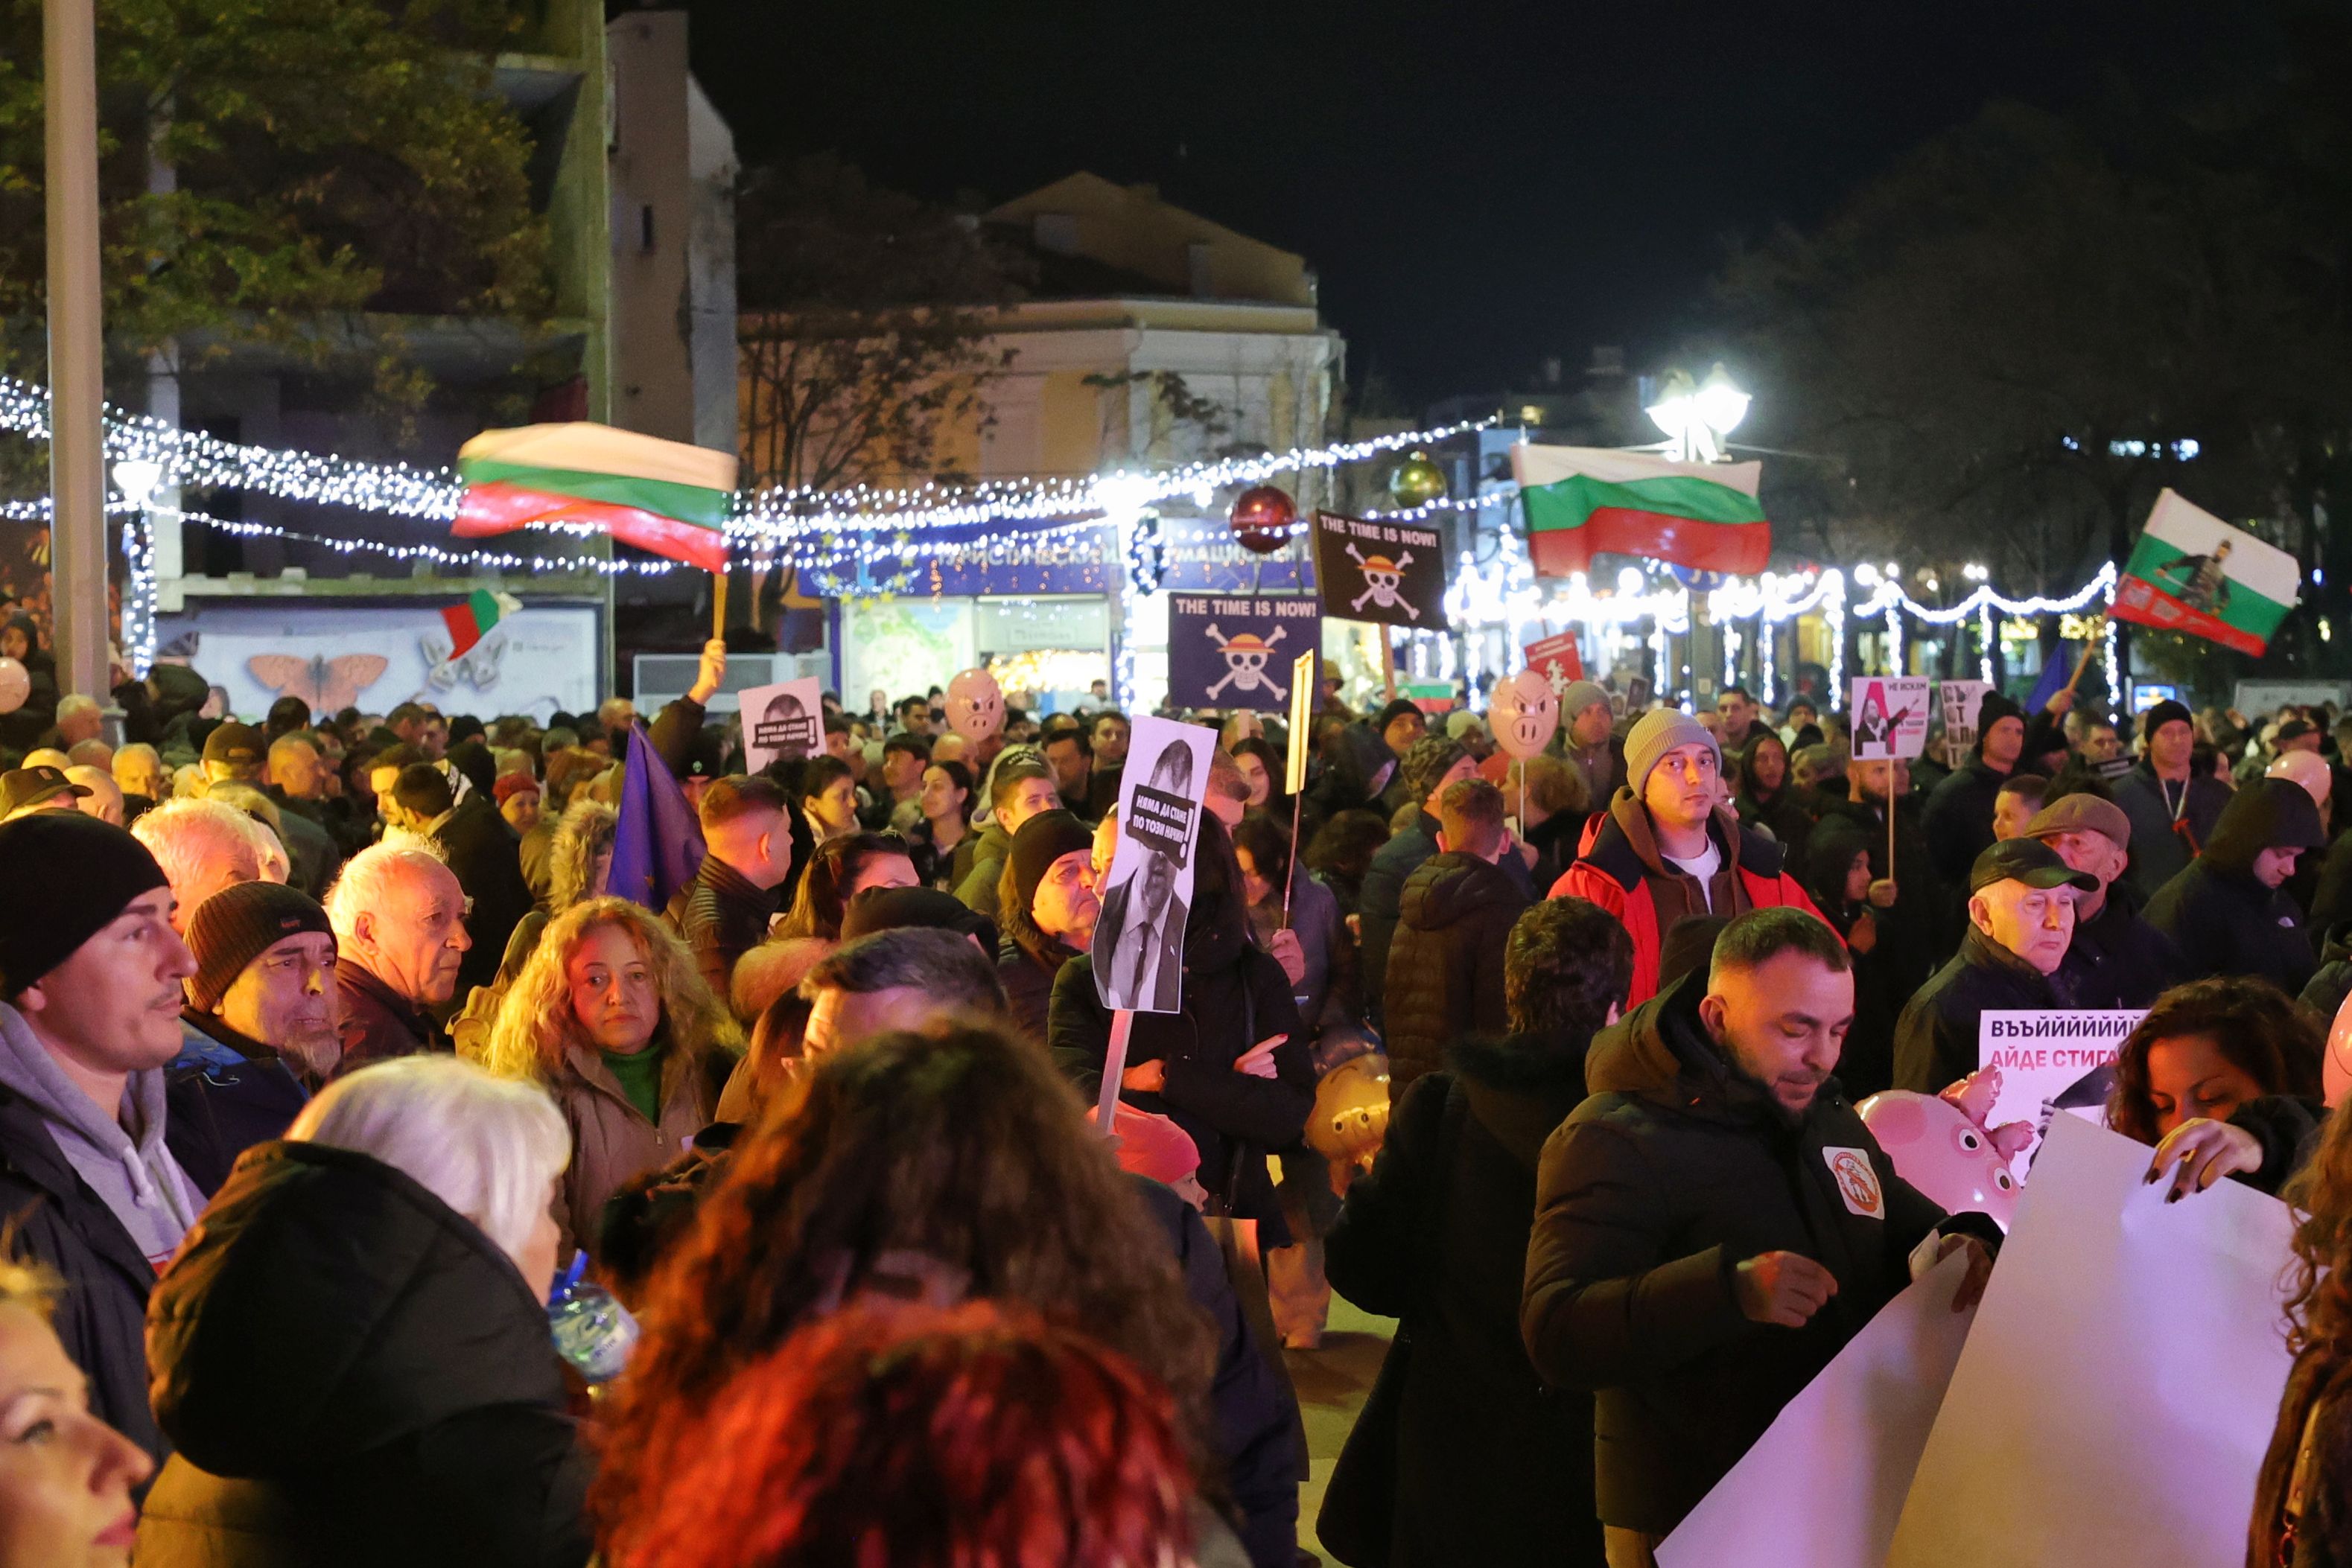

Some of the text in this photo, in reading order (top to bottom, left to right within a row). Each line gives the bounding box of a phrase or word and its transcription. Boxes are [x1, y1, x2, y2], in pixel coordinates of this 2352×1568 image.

[1320, 514, 1437, 547] THE TIME IS NOW!
[1175, 599, 1317, 617] THE TIME IS NOW!
[1136, 794, 1187, 823] НЯМА ДА СТАНЕ
[1133, 815, 1144, 829] ПО
[1145, 818, 1166, 836] ТОЗИ
[1990, 1045, 2047, 1071] АЙДЕ
